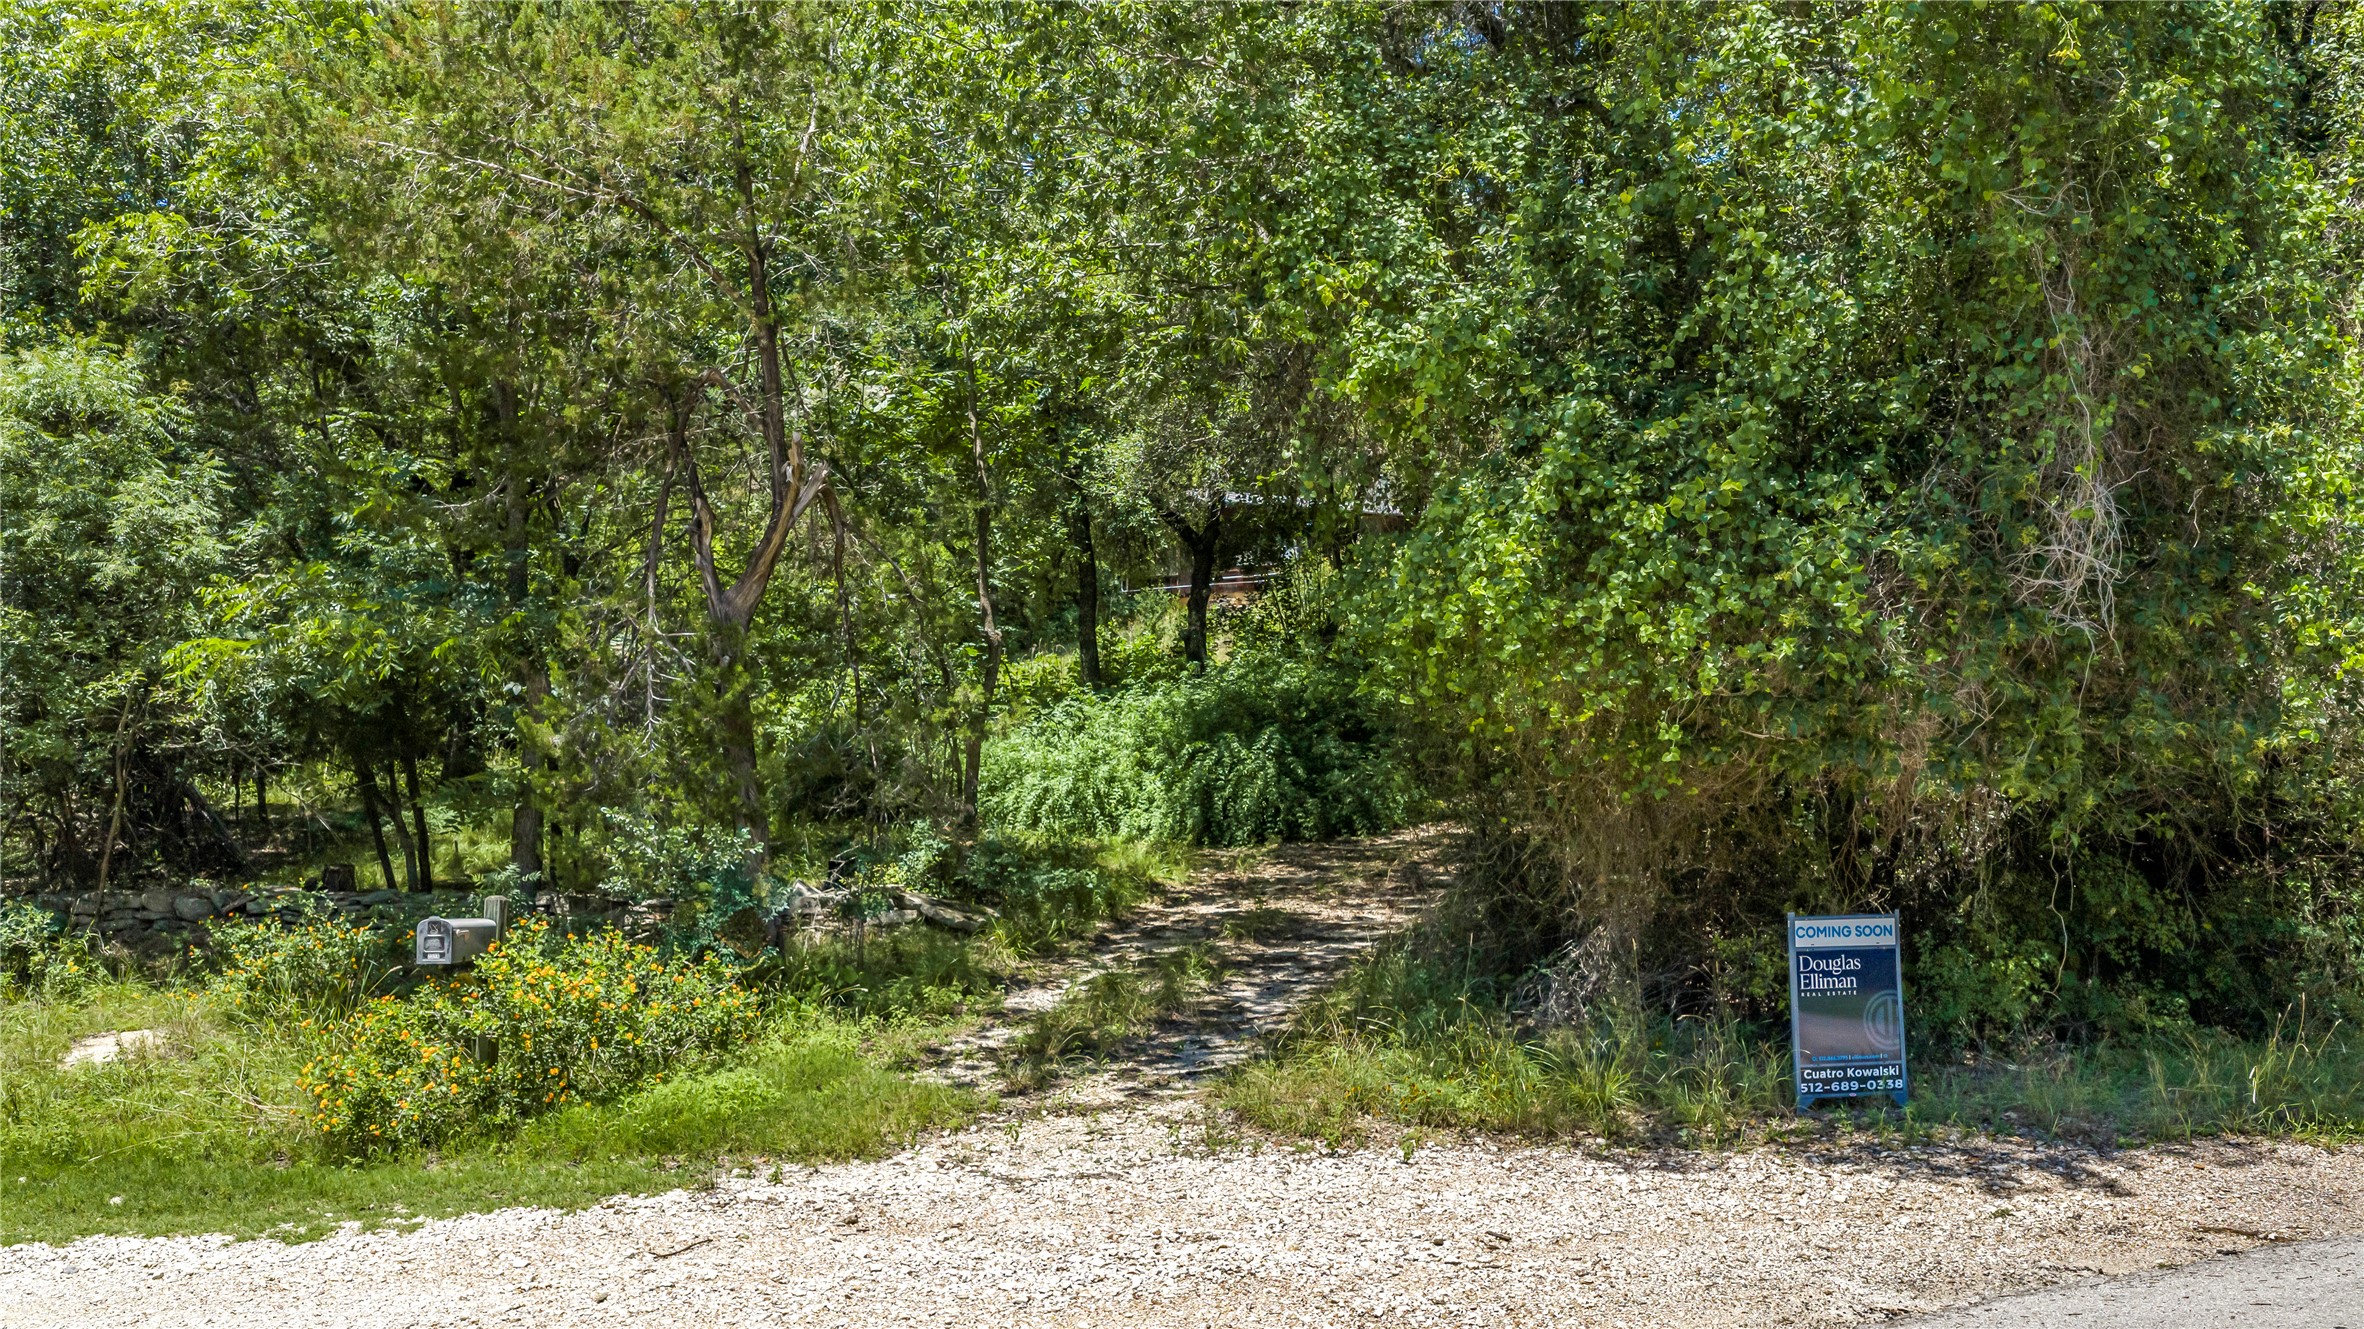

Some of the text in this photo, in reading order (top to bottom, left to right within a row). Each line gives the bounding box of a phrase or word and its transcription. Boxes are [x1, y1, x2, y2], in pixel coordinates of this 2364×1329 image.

[1795, 924, 1893, 939] COMING SOON
[1798, 954, 1861, 975] Douglas
[1800, 973, 1857, 990] Elliman
[1803, 1065, 1899, 1080] Cuatro Kowalski
[1800, 1079, 1903, 1093] 512-689-0338
